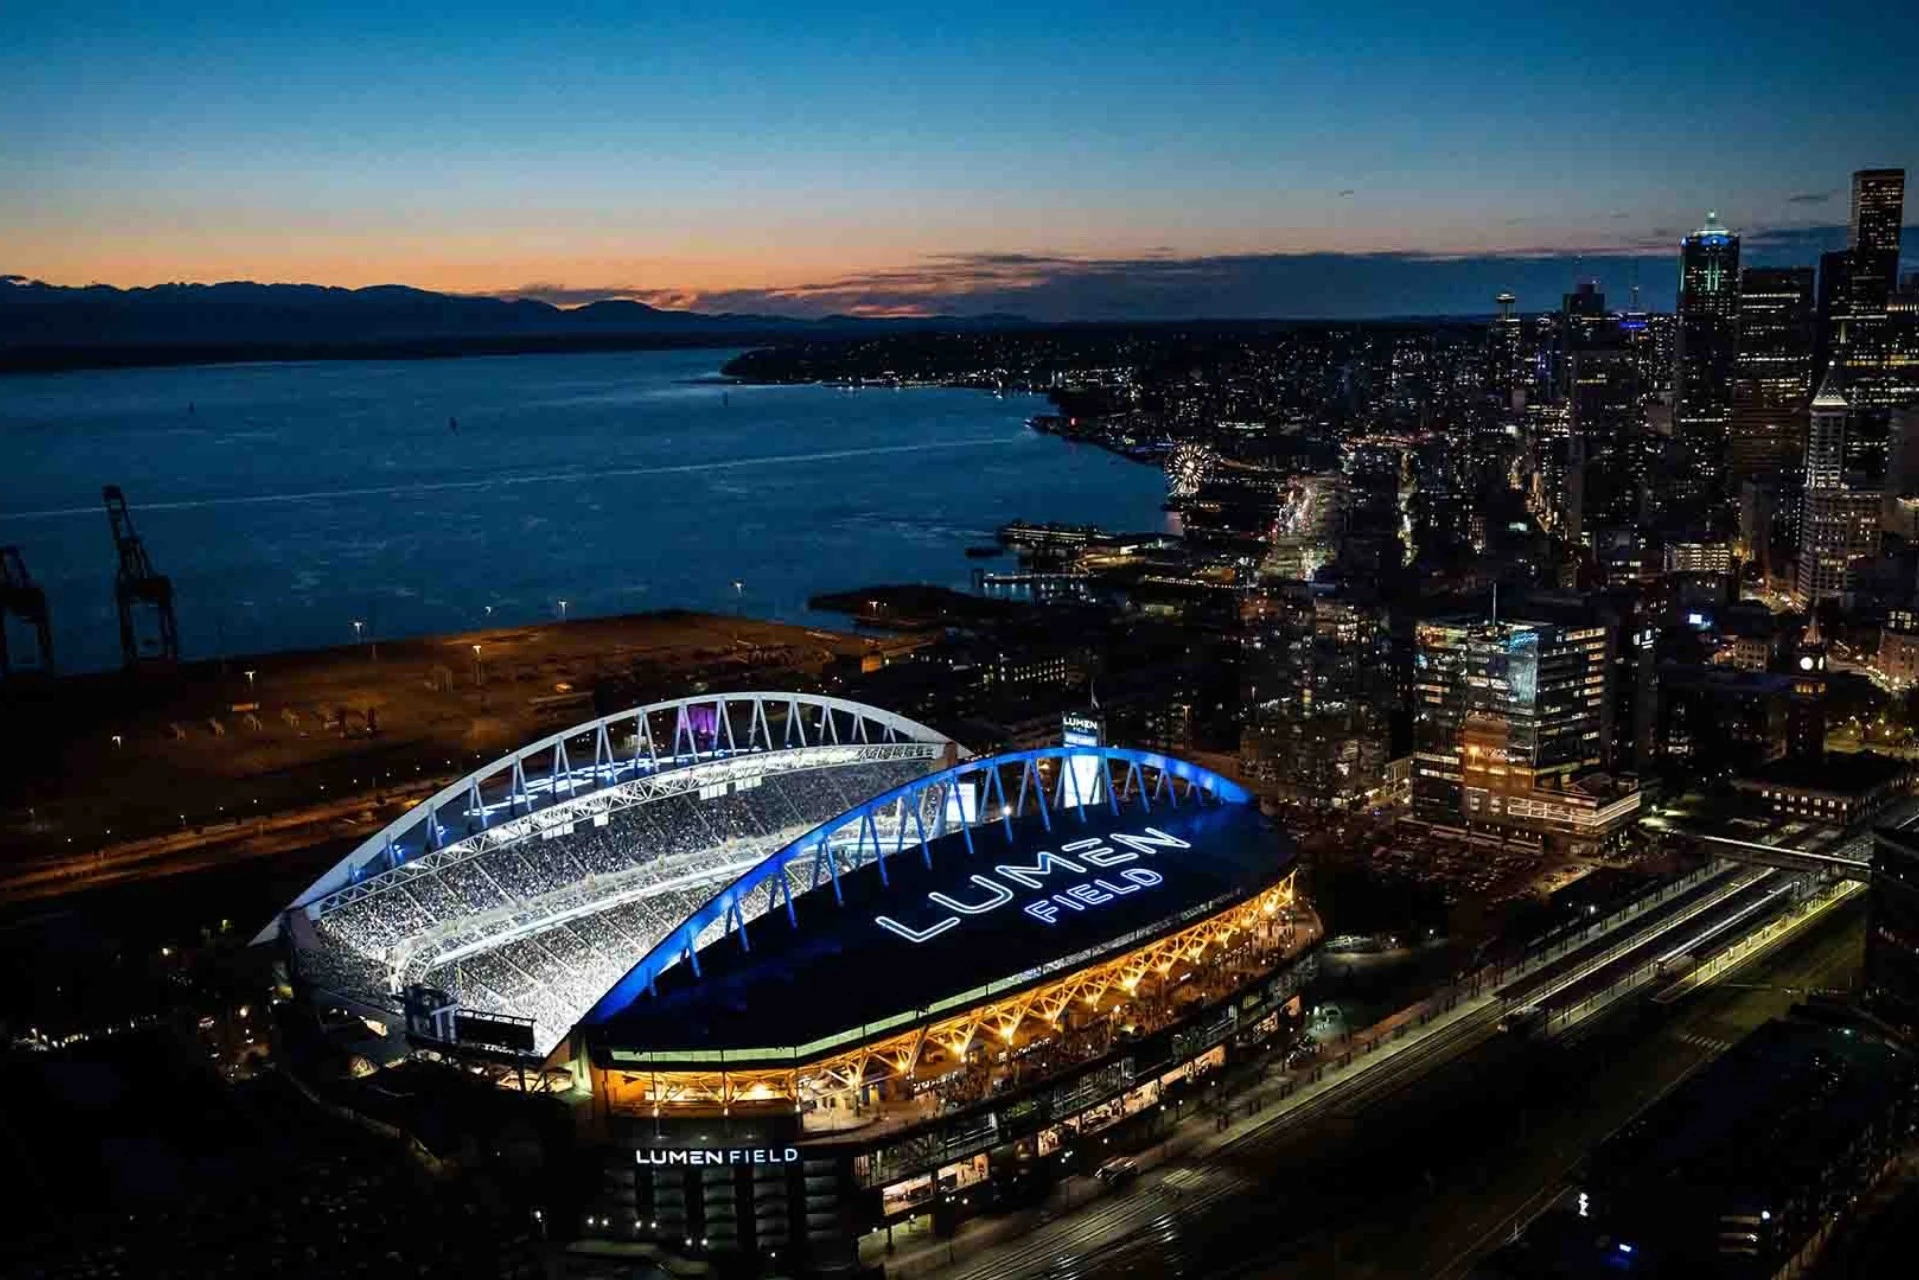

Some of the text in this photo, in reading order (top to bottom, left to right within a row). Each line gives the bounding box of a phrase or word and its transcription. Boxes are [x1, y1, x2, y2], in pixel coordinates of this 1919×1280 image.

[1062, 716, 1098, 730] LUMEN
[874, 827, 1191, 943] LUMEN
[1024, 868, 1163, 923] FIELD
[635, 1149, 798, 1165] LUMEN FIELD
